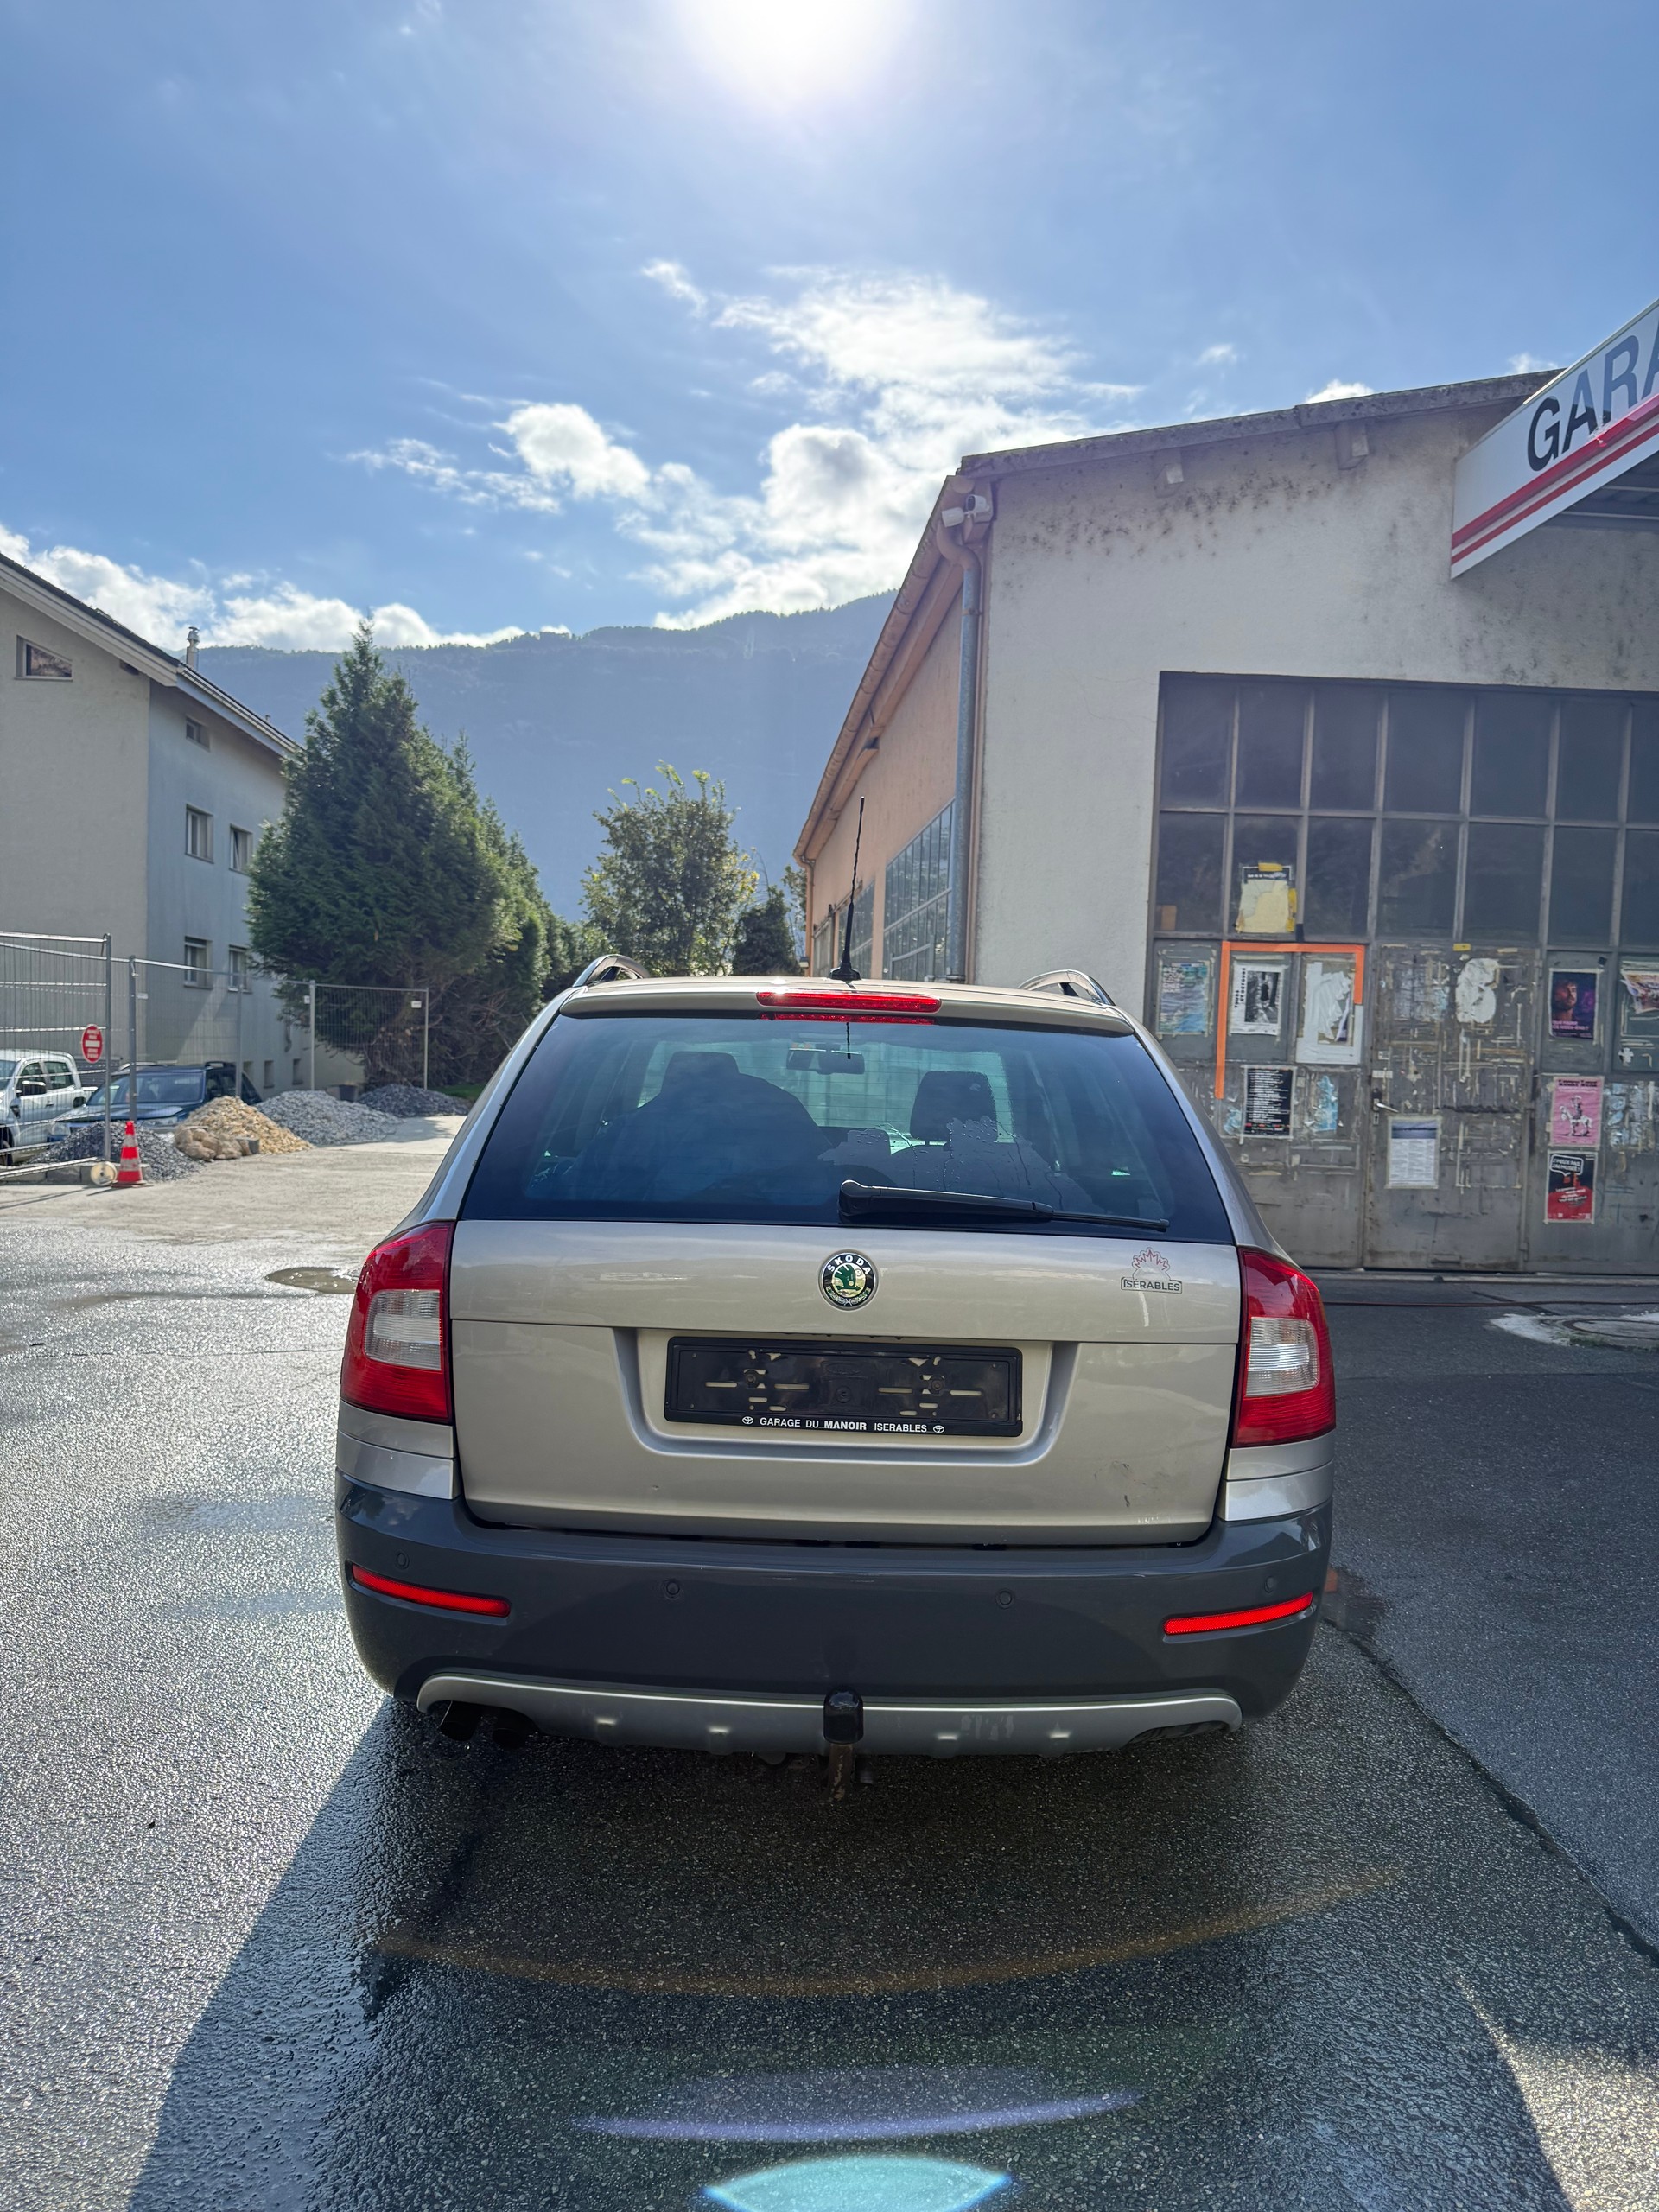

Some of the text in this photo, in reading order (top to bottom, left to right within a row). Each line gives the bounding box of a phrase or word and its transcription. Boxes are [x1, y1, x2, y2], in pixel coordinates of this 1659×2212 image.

[760, 1417, 927, 1433] GARAGE DU MANOIR ISERABLES
